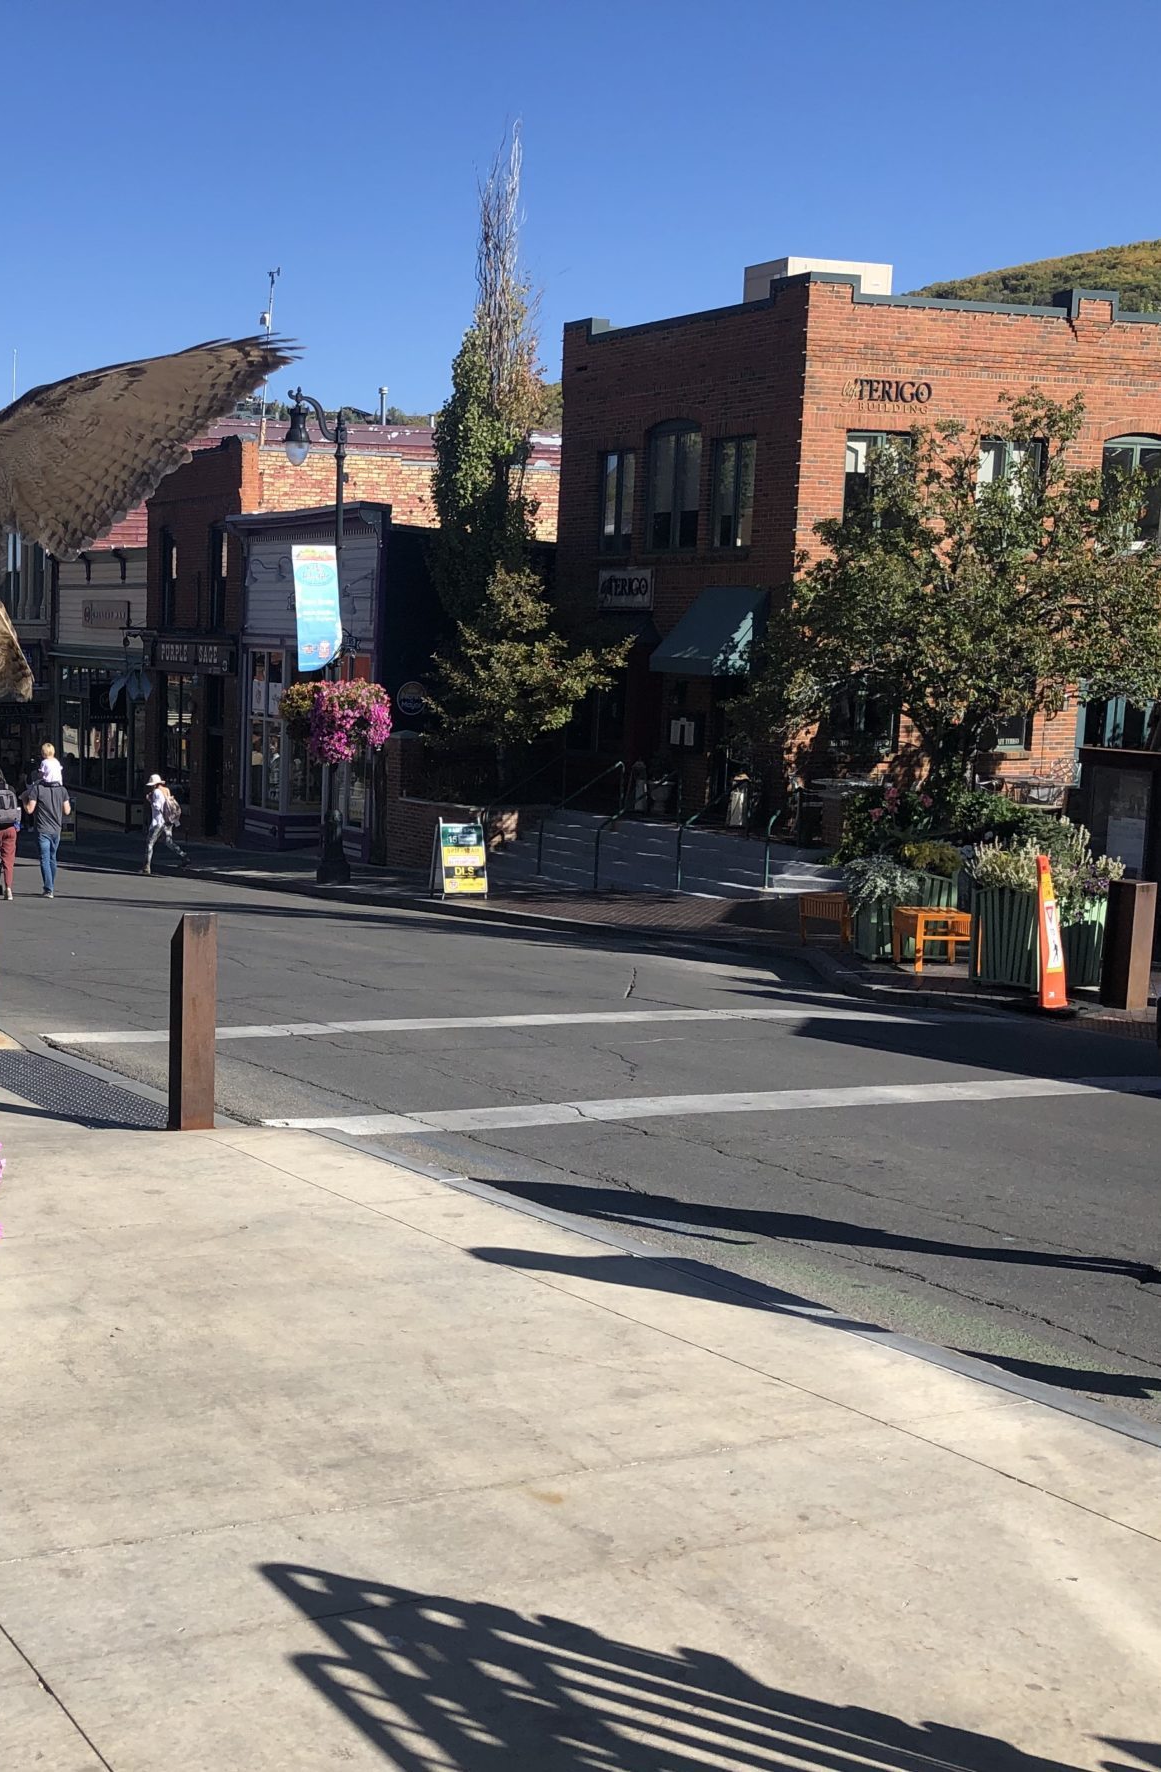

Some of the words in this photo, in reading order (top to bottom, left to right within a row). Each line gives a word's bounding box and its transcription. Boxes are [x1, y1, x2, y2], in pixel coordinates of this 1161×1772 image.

[854, 378, 933, 404] TERIGO
[857, 402, 929, 415] BUILDING
[161, 643, 188, 662] PURPLE
[198, 645, 218, 664] SAGE
[454, 866, 475, 876] DLS
